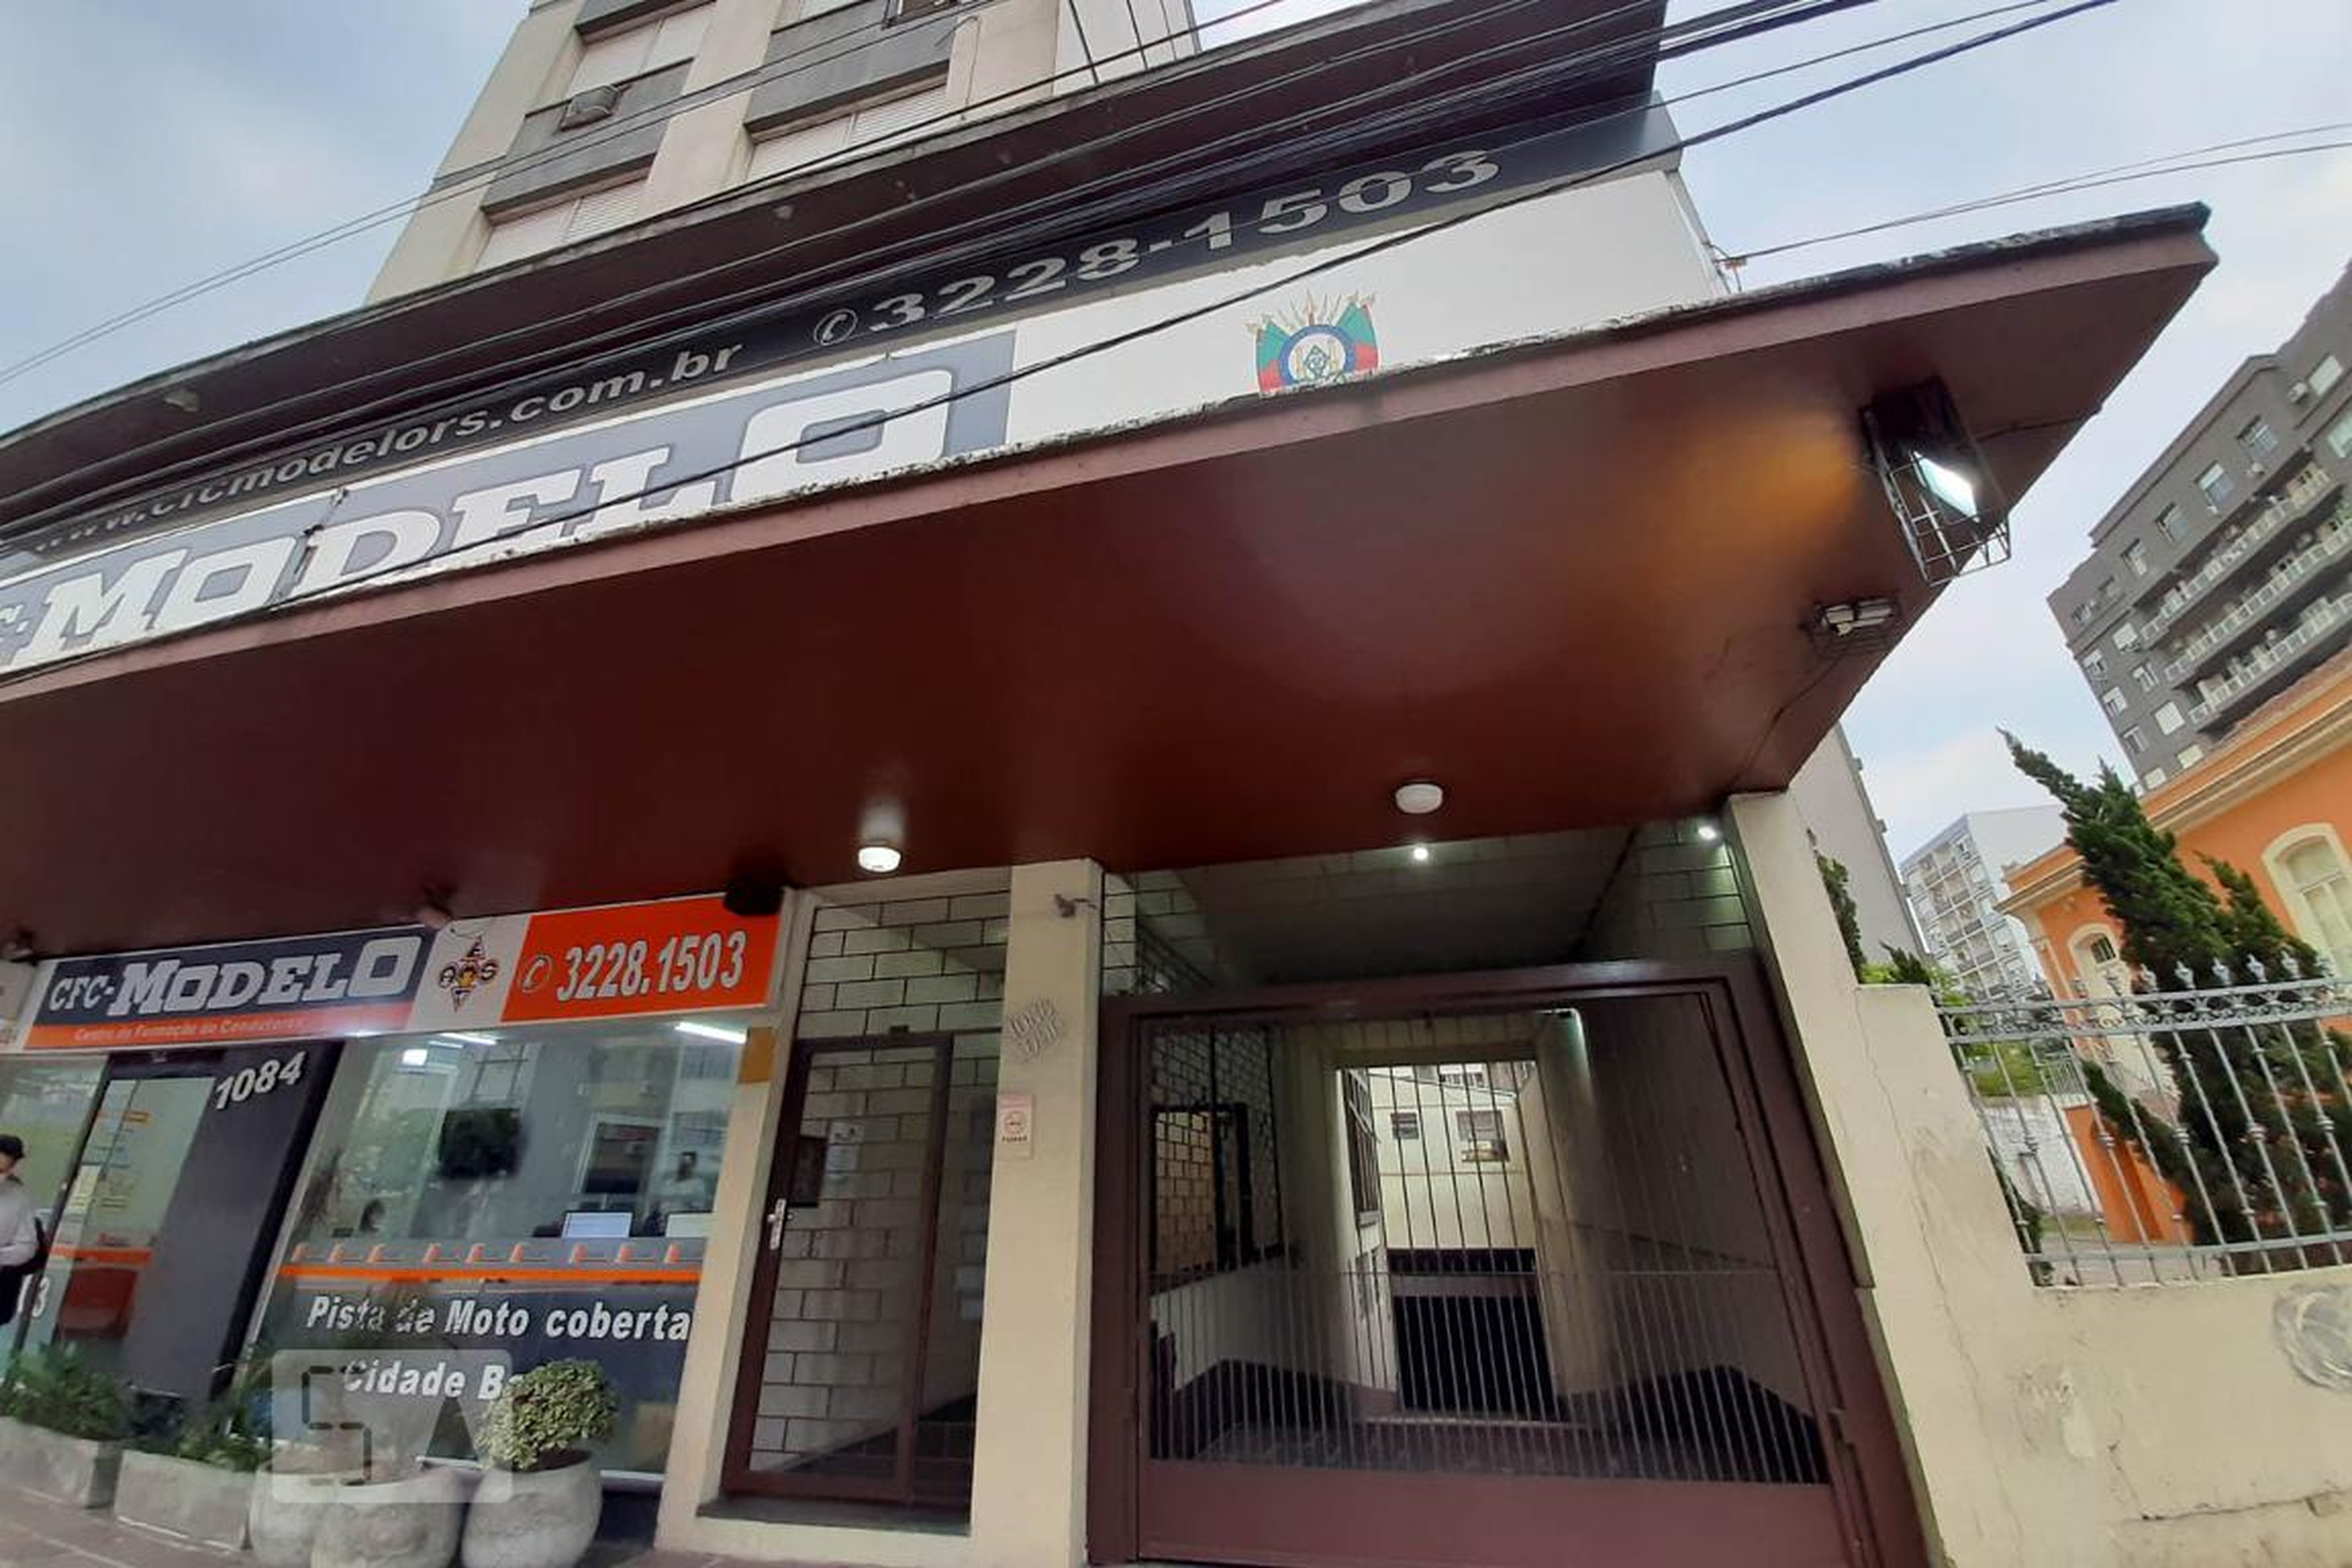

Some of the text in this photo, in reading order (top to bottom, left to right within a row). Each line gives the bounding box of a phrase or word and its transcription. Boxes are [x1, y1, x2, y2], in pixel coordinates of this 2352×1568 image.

[867, 149, 1500, 332] 3228-1503
[557, 930, 748, 1001] 3228.1503
[216, 1052, 306, 1109] 1084
[307, 1295, 385, 1332] Pista
[445, 1299, 529, 1336] Moto
[546, 1301, 693, 1340] coberta
[342, 1359, 466, 1398] Cidade
